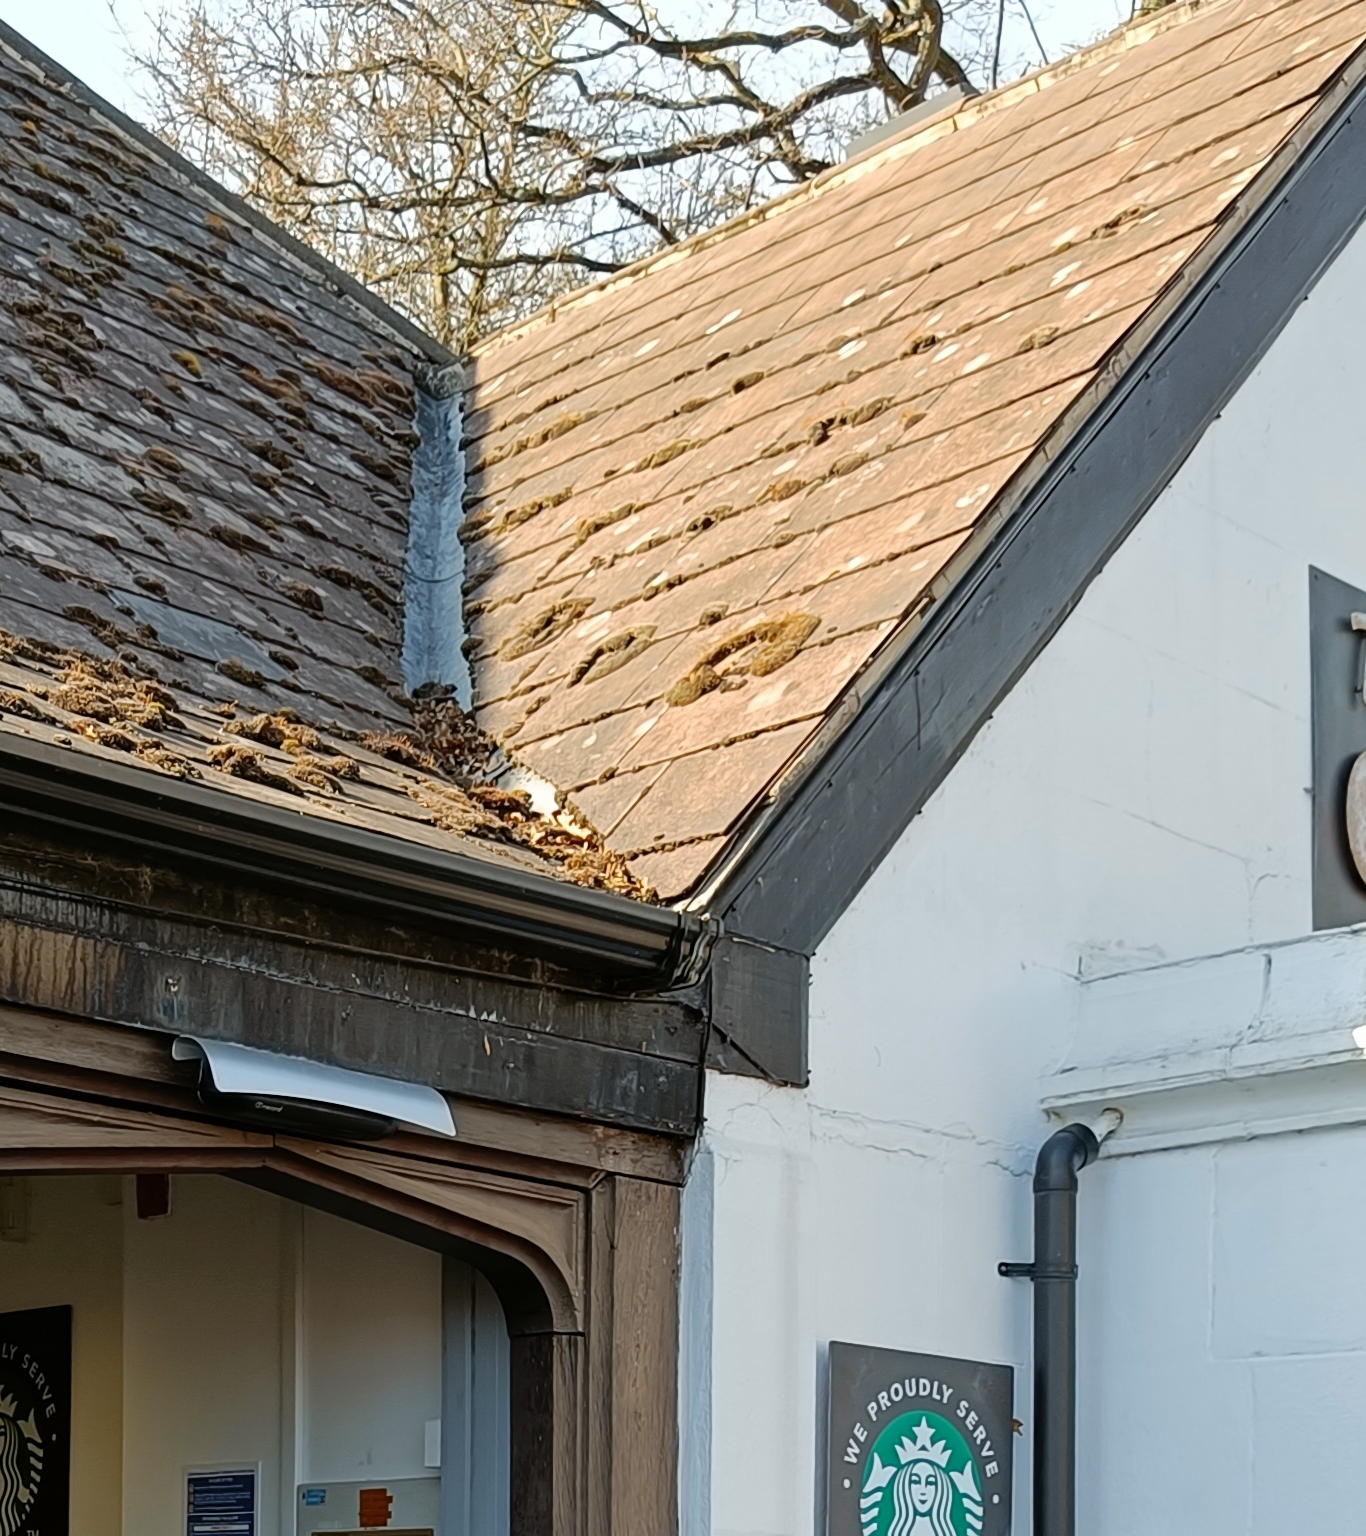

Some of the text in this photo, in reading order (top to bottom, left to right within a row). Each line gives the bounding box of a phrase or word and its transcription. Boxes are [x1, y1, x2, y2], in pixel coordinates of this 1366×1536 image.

[21, 1354, 56, 1418] SERVE
[844, 1378, 999, 1478] WE PROUDLY SERVE
